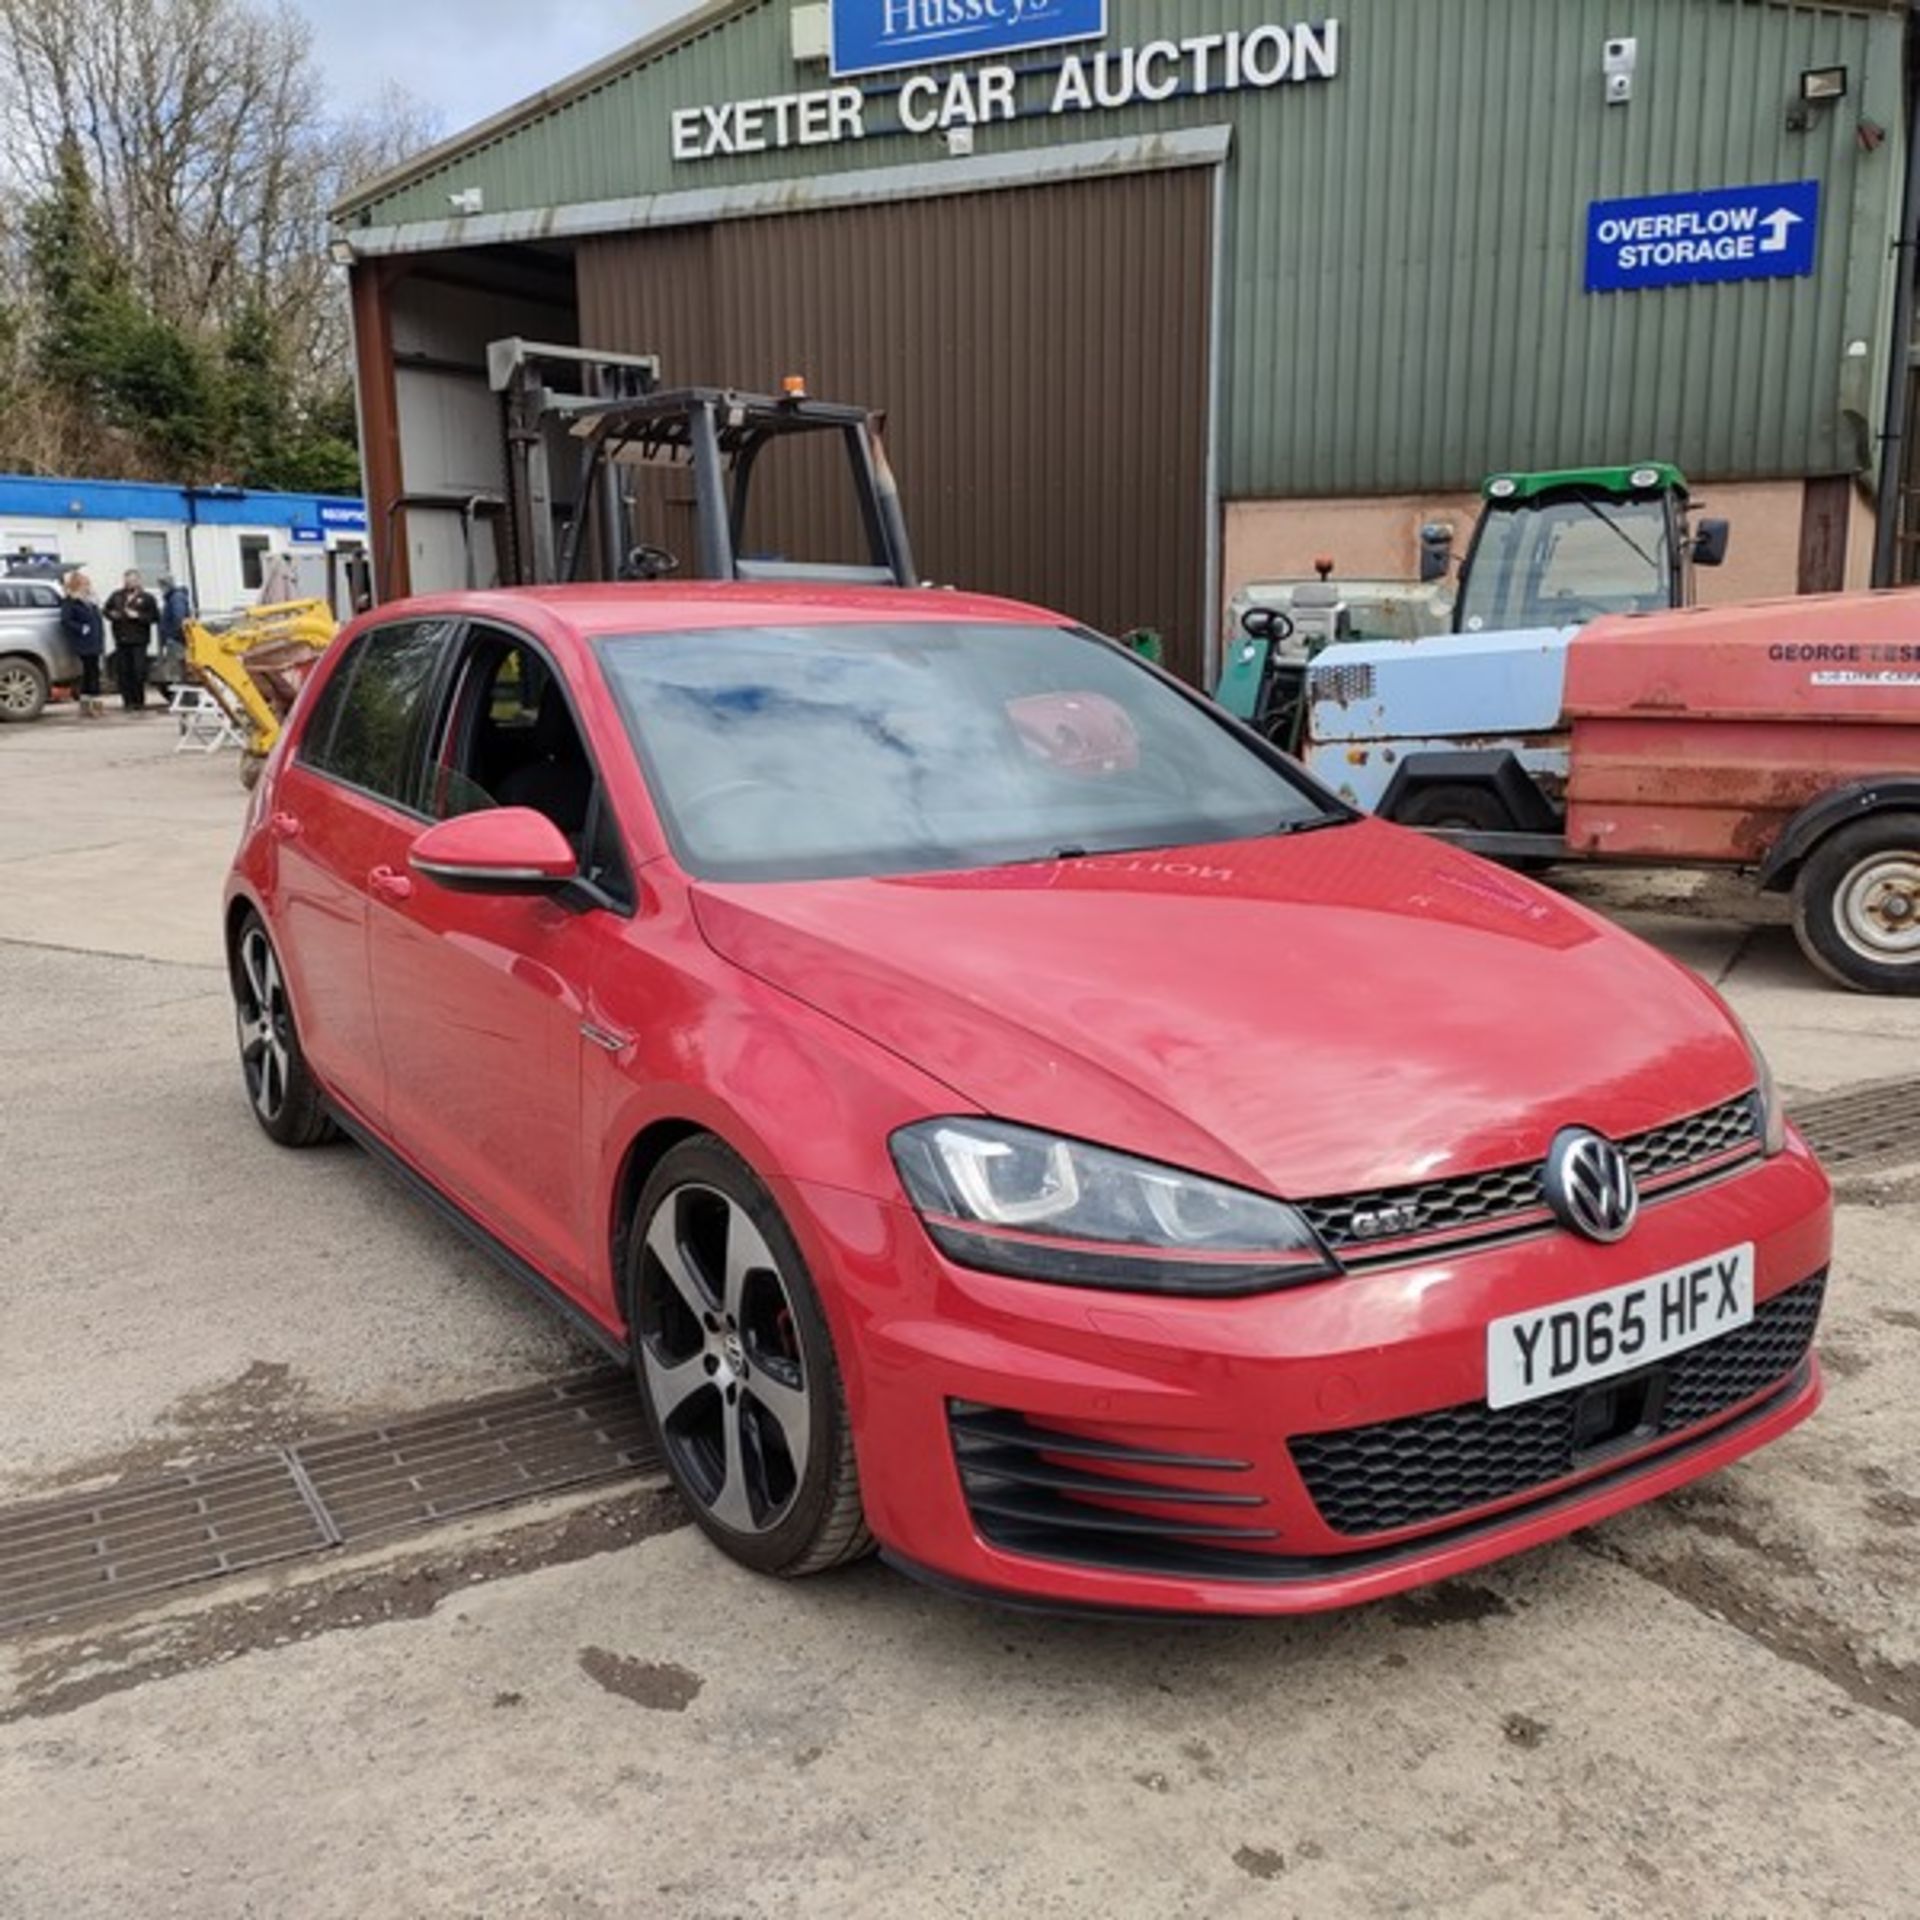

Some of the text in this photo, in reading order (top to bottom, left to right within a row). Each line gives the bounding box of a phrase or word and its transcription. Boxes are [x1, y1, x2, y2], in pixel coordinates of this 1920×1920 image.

[671, 19, 1339, 161] EXETER CAR AUCTION
[1597, 207, 1758, 244] OVERFLOW
[1618, 236, 1755, 269] STORAGE
[1769, 644, 1860, 662] GEORGE
[1513, 1256, 1739, 1385] YD65 HFX
